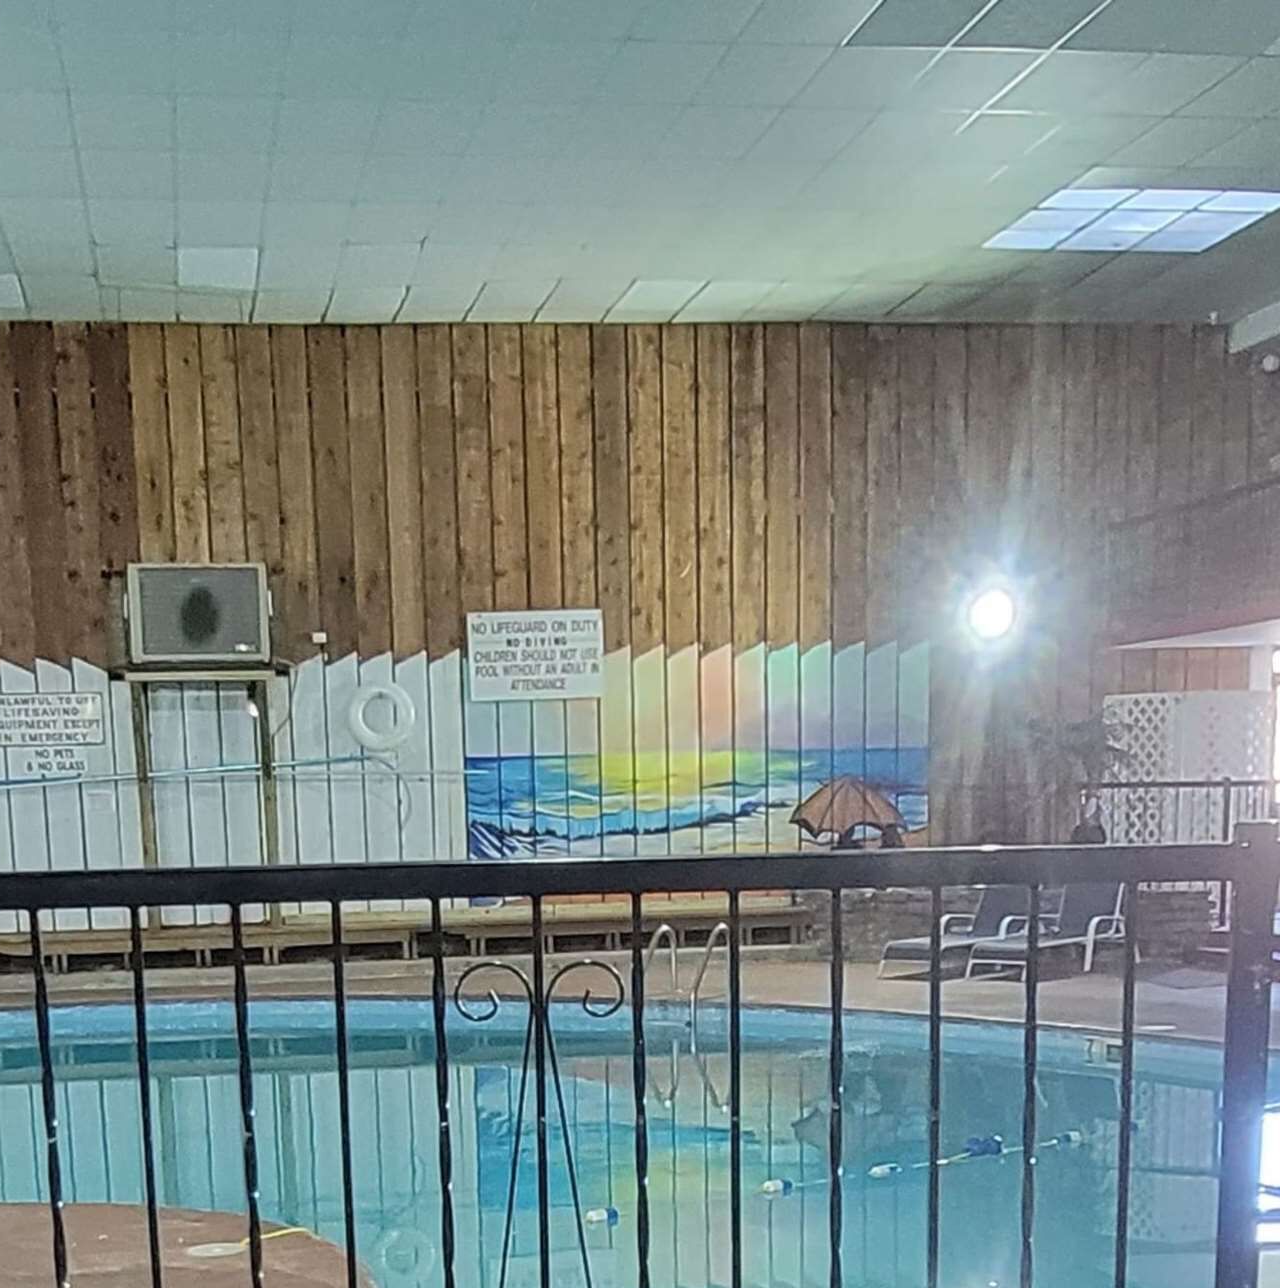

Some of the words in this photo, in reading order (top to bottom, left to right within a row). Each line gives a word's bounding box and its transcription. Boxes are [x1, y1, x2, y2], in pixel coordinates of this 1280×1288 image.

[472, 623, 487, 635] NO
[491, 621, 547, 634] LIFEGUARD
[551, 620, 567, 632] ON
[571, 620, 598, 632] DUTY
[525, 636, 567, 647] DIVING
[473, 651, 517, 663] CHILDREN
[521, 650, 556, 661] SHOULD
[502, 664, 541, 676] WITHOUT
[511, 678, 565, 691] ATTENDANCE
